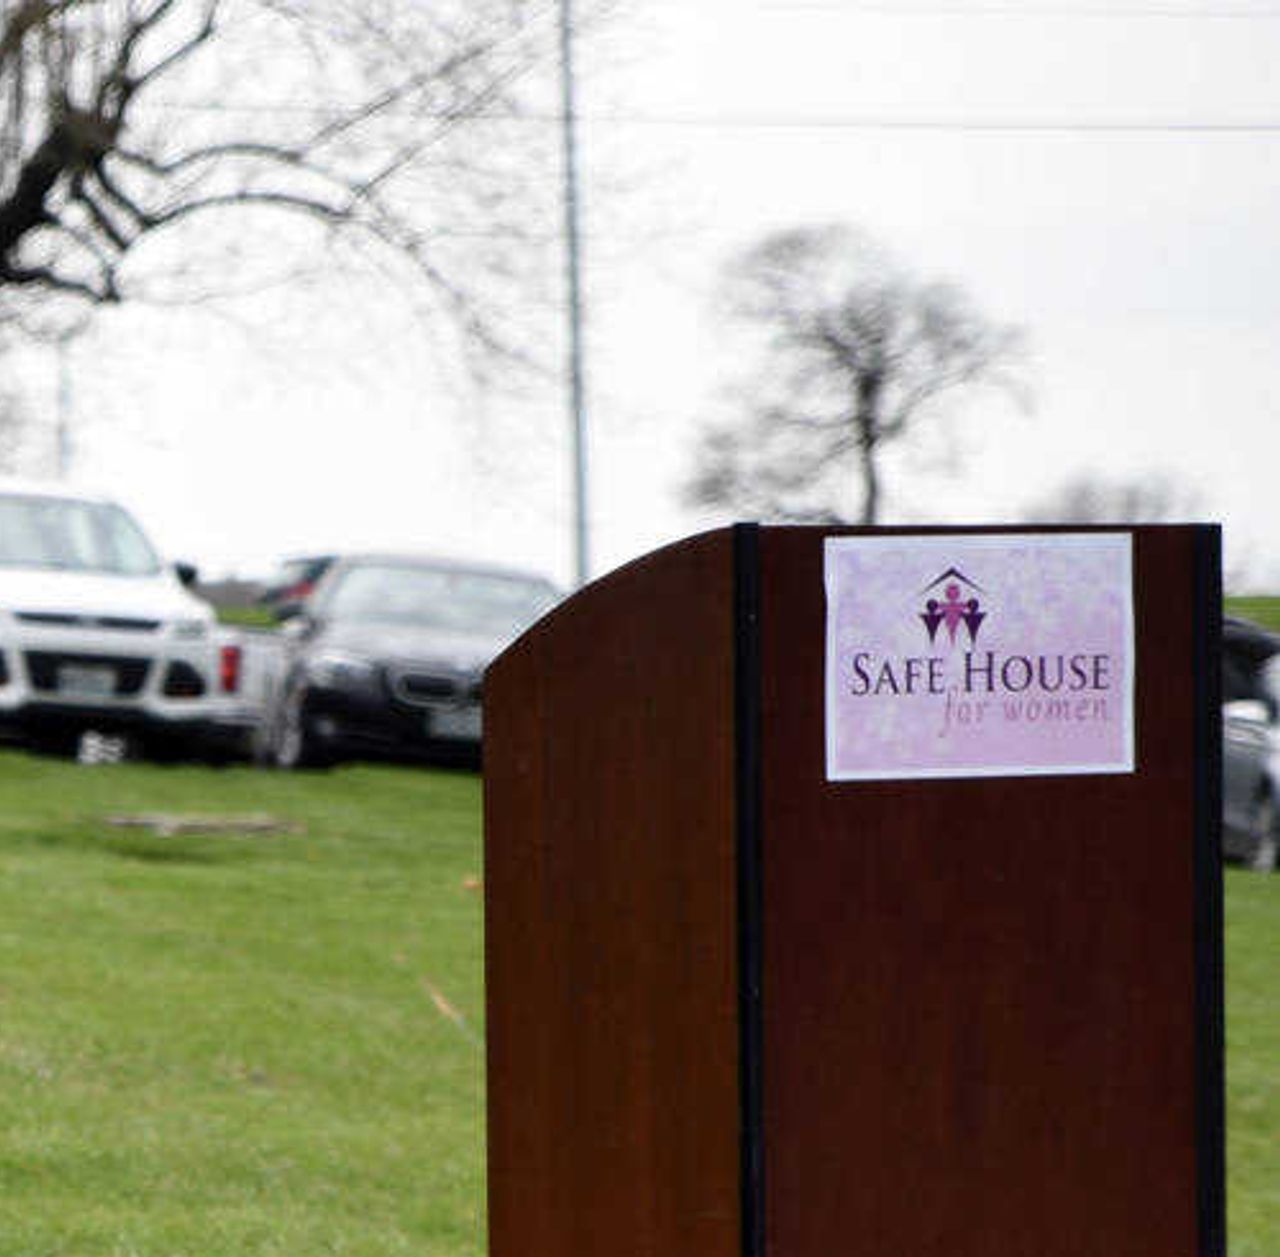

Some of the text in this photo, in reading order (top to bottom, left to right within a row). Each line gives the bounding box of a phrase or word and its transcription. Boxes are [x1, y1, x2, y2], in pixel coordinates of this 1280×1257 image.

[851, 652, 1111, 696] SAFE HOUSE
[937, 684, 1109, 739] for women
